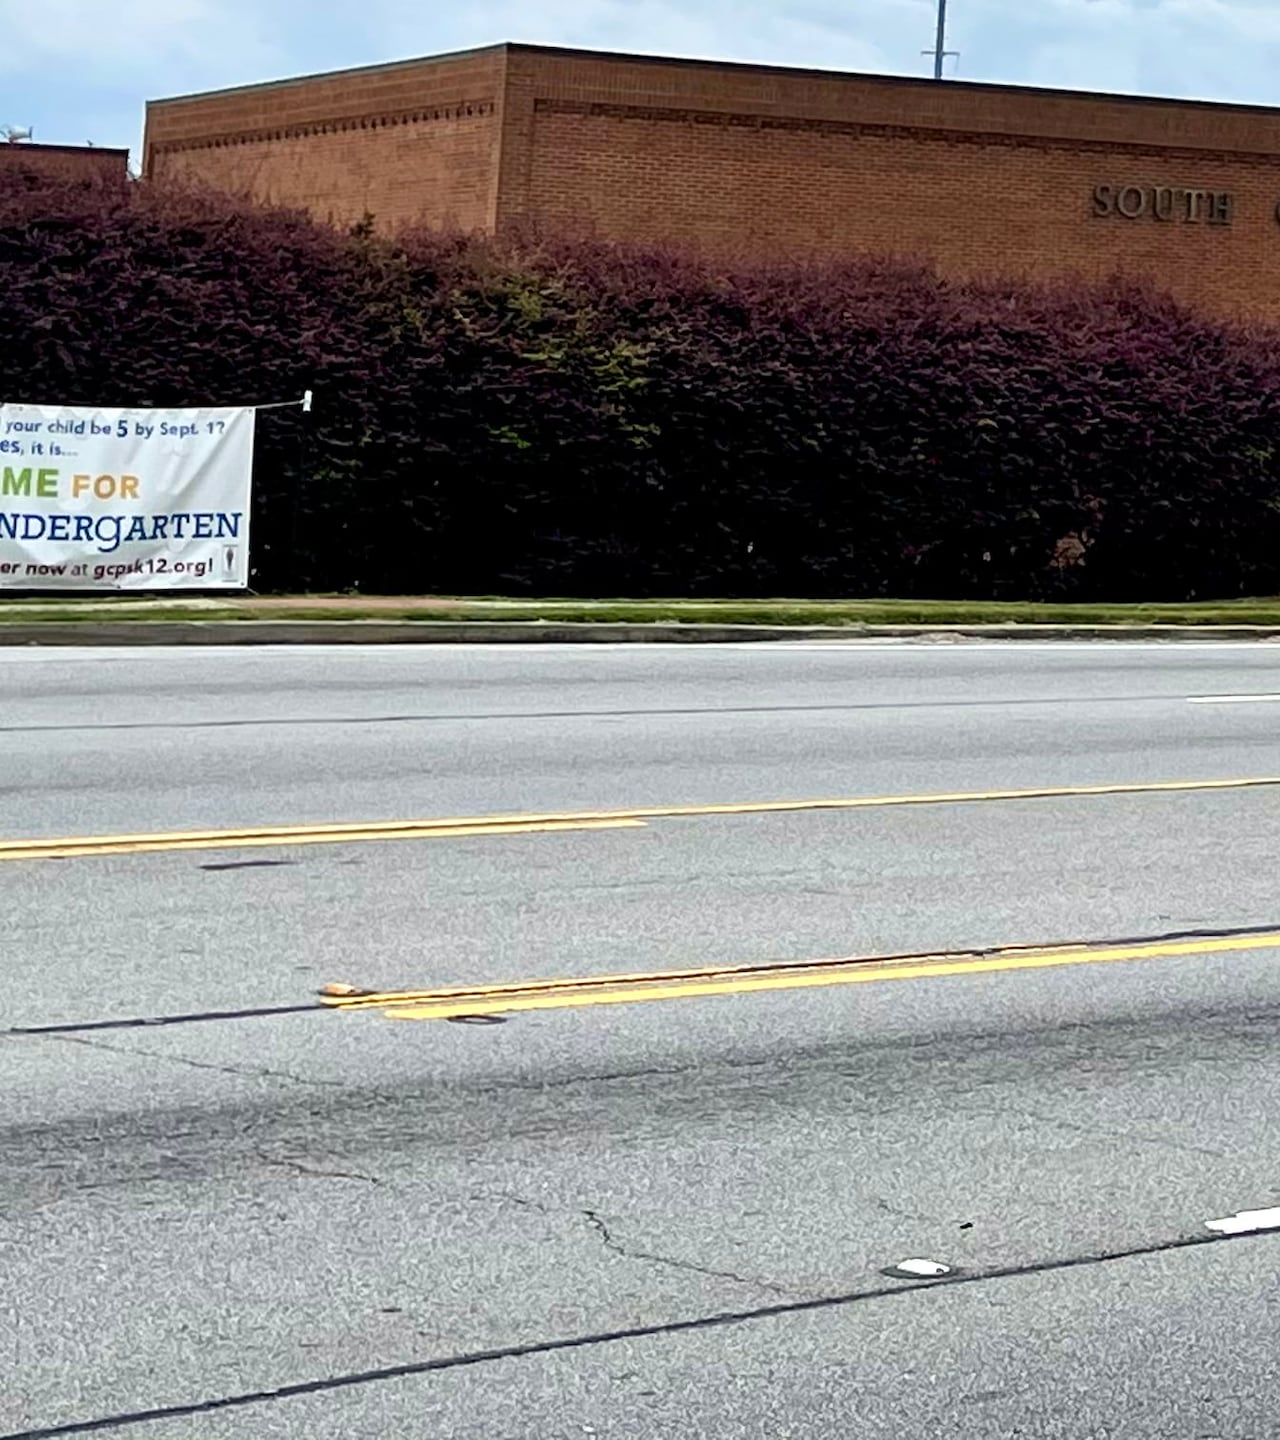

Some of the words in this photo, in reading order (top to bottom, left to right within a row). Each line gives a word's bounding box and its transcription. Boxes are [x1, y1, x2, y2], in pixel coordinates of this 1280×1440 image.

[1092, 184, 1232, 226] SOUTH
[5, 420, 42, 434] your
[48, 419, 85, 435] child
[91, 420, 111, 435] be
[116, 420, 128, 438] 5
[135, 422, 154, 440] by
[160, 422, 198, 439] Sept.
[206, 421, 225, 435] 1?
[31, 441, 43, 456] it
[2, 466, 59, 498] ME
[71, 474, 140, 500] FOR
[0, 562, 21, 576] er
[25, 562, 66, 576] now
[71, 561, 88, 576] at
[93, 558, 213, 579] gcpsk12.org!
